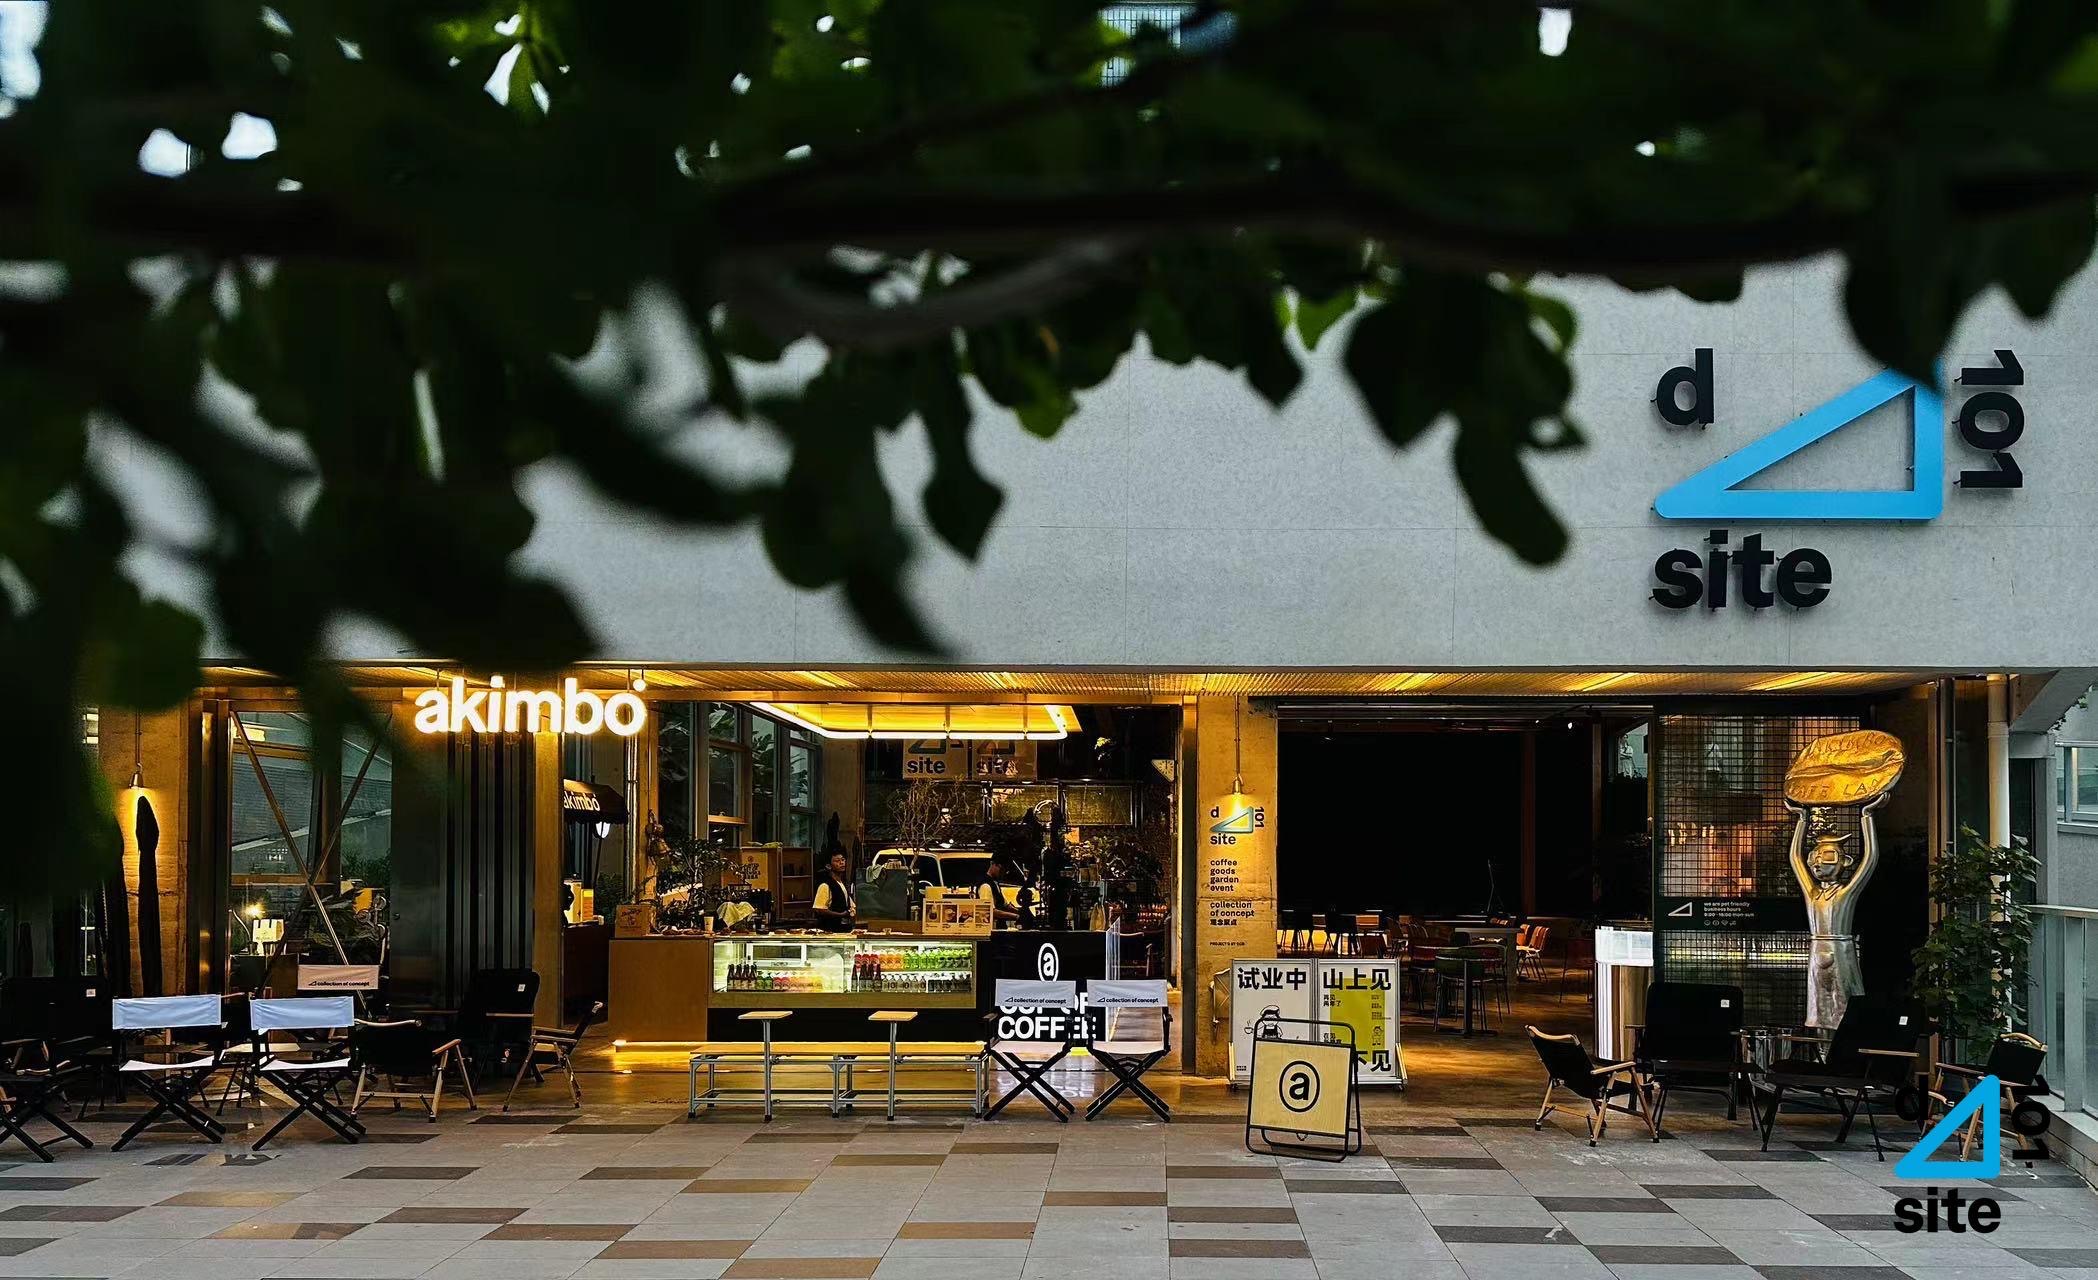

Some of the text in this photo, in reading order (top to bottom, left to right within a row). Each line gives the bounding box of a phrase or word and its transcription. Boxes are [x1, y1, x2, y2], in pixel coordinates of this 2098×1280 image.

[1656, 348, 1714, 426] d
[1959, 349, 2025, 489] 101
[1652, 529, 1832, 609] site
[414, 675, 647, 736] akimbo
[907, 757, 946, 774] site
[564, 791, 600, 811] akimbo
[1211, 806, 1219, 818] d
[1255, 807, 1264, 828] 101
[1210, 833, 1236, 845] site
[1210, 867, 1235, 875] goods
[1210, 876, 1239, 884] garden
[1220, 909, 1254, 918] concept
[1238, 967, 1307, 991] 试业中
[1323, 968, 1392, 991] 山上见
